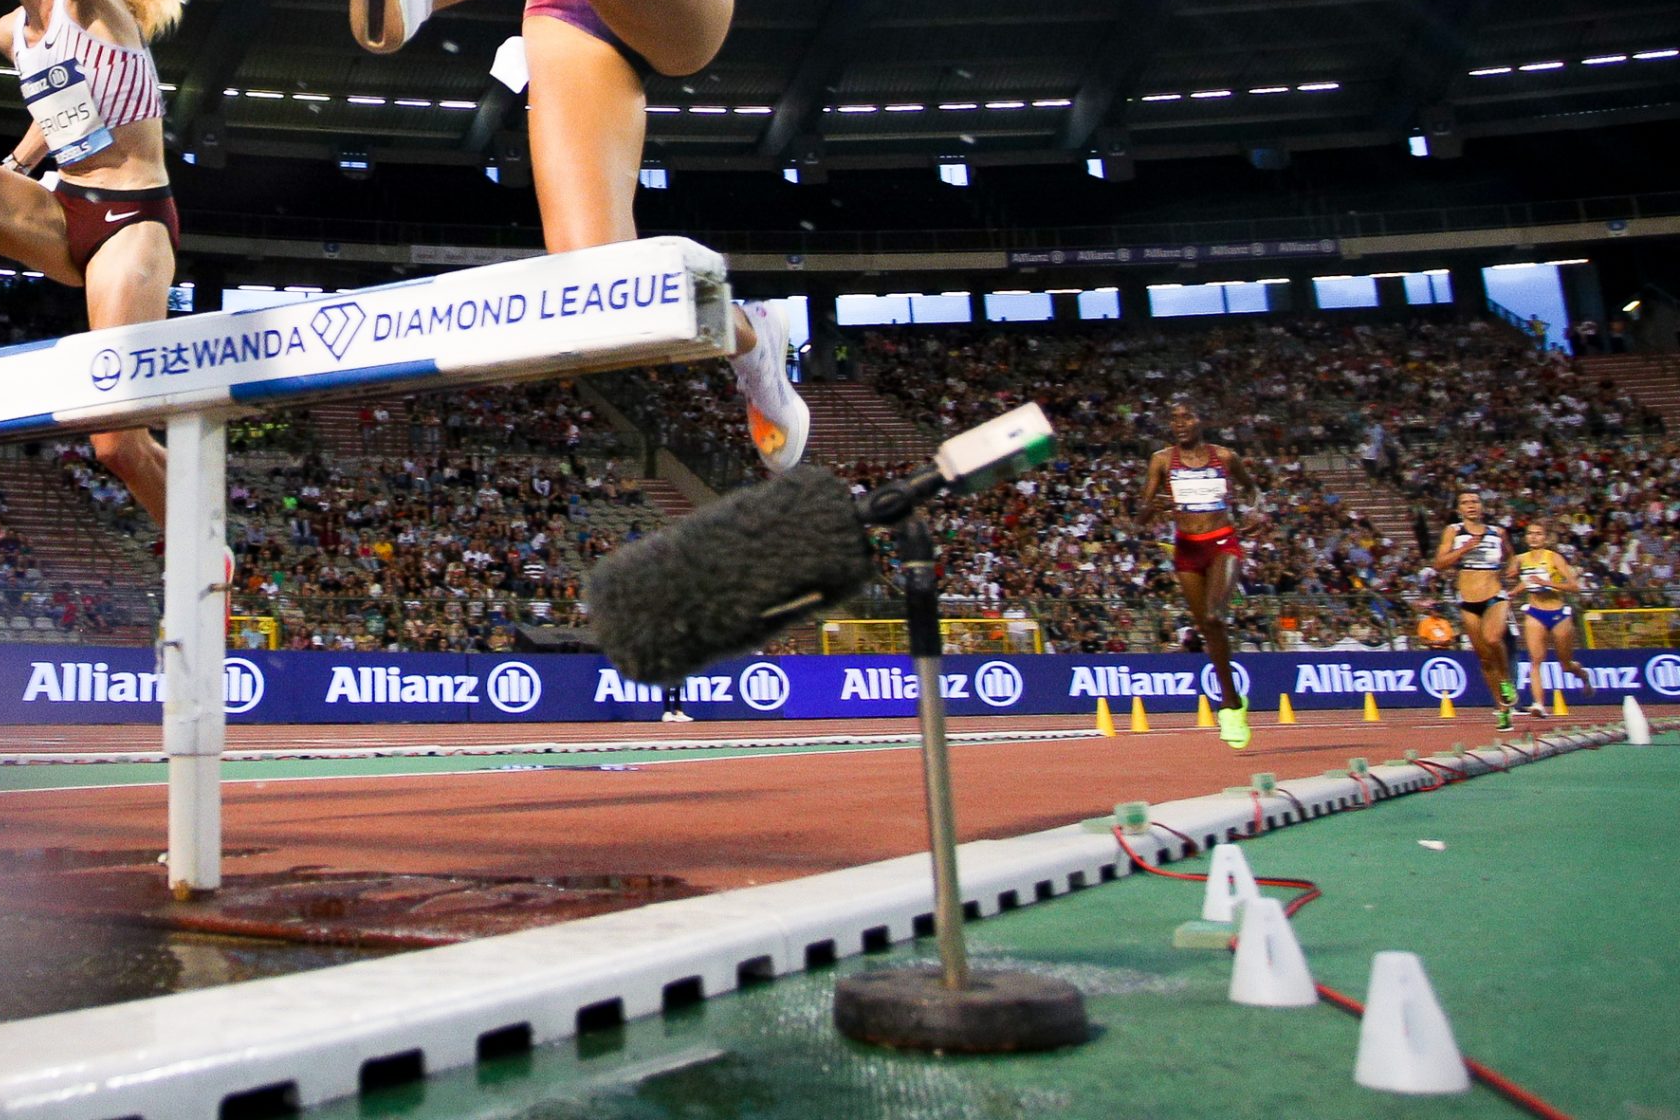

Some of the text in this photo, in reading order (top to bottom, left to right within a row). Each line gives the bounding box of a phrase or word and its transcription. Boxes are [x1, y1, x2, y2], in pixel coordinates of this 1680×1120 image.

[373, 294, 527, 342] DIAMOND
[539, 271, 683, 319] LEAGUE
[325, 666, 480, 703] Allianz
[1069, 665, 1197, 697] Allianz
[1295, 663, 1418, 694] Allianz
